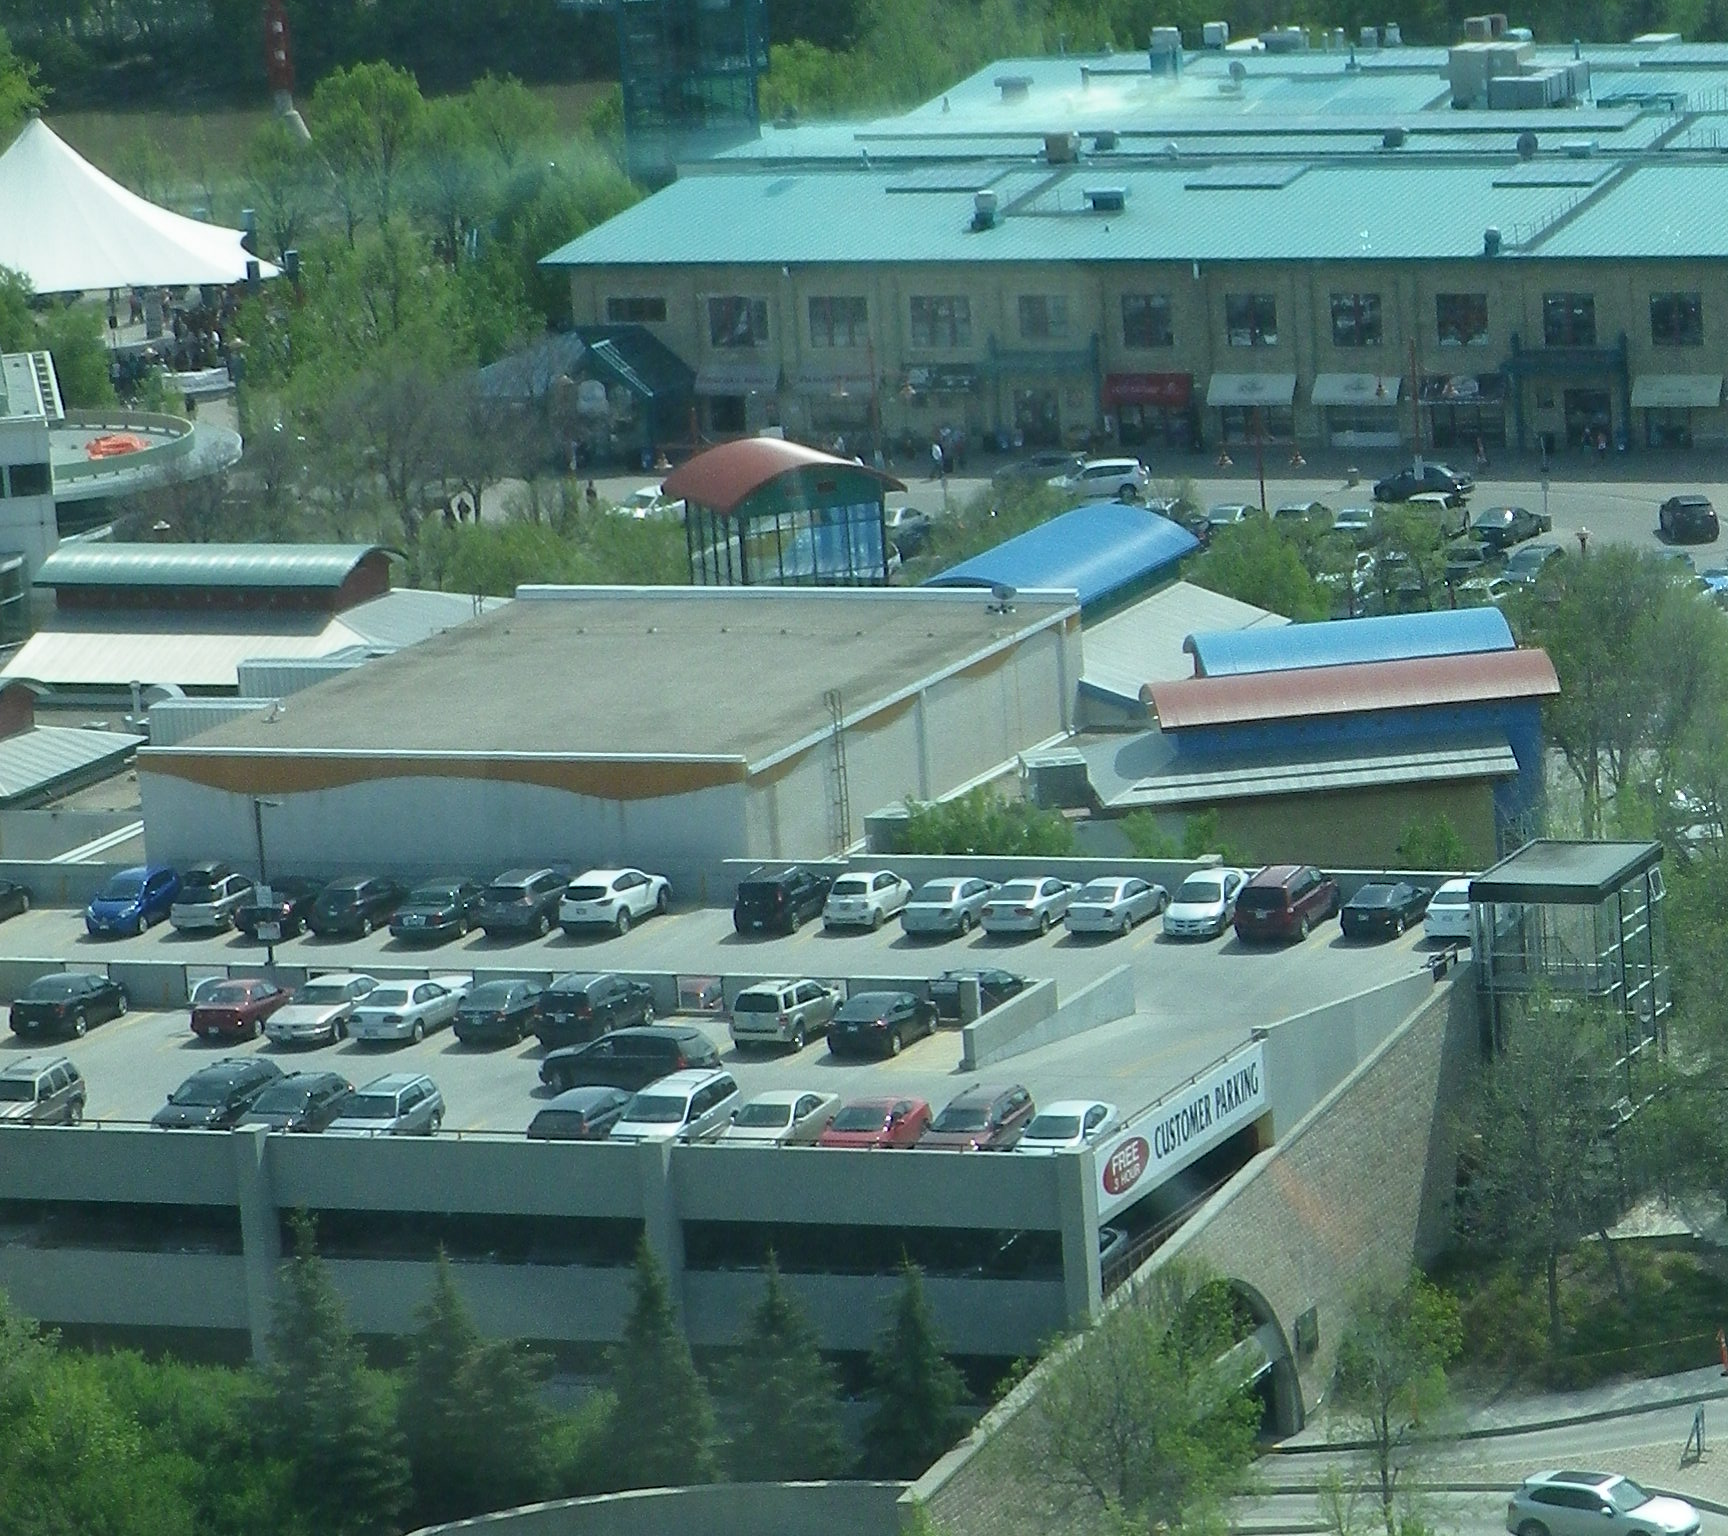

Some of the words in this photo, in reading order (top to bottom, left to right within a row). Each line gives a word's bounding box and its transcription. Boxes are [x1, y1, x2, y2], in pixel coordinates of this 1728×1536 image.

[1154, 1094, 1213, 1160] CUSTOMER
[1214, 1062, 1259, 1120] PARKING
[1111, 1140, 1141, 1176] FREE
[1121, 1163, 1141, 1187] HOUR
